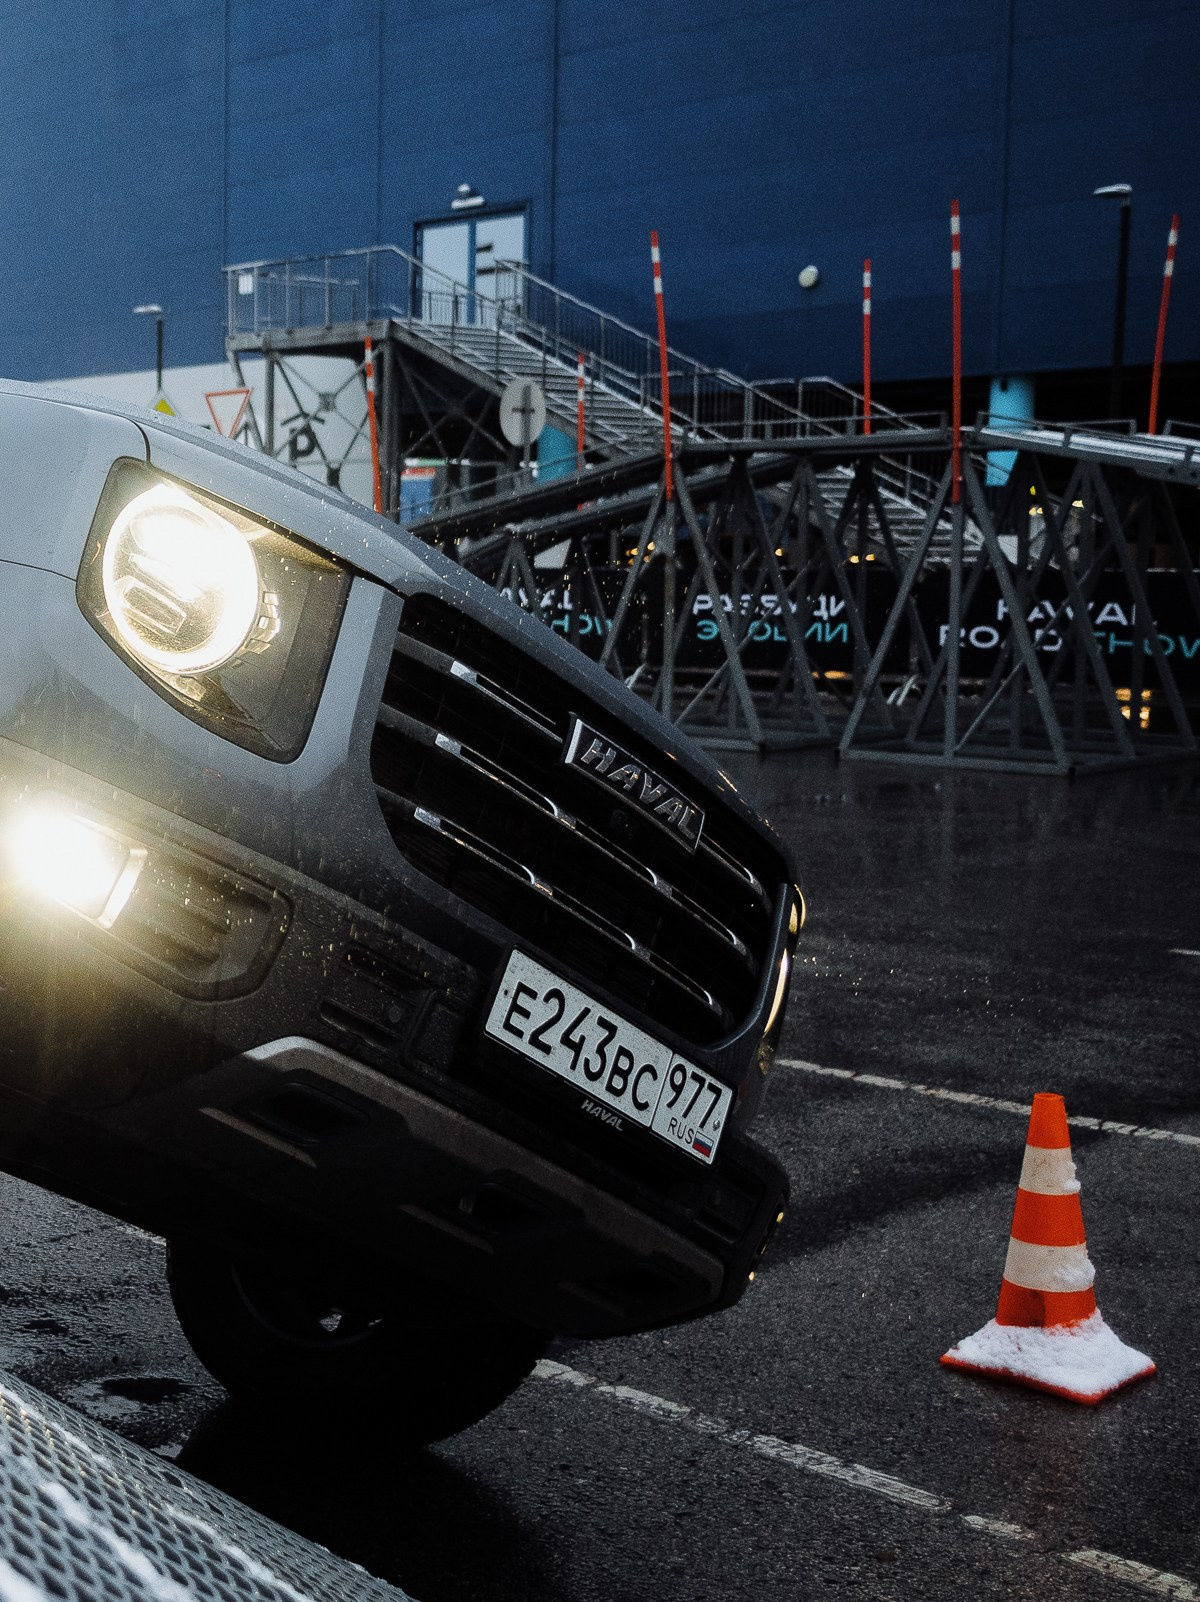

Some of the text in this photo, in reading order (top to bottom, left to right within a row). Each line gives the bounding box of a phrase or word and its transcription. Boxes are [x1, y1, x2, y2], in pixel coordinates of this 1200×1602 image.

[499, 587, 573, 610] AVAL
[696, 619, 848, 643] ЭОЦИИ
[939, 625, 1063, 652] ROD
[580, 738, 696, 840] HAVAL
[666, 1063, 722, 1130] 977
[581, 1099, 625, 1132] HAVAL
[667, 1117, 694, 1145] RUS
